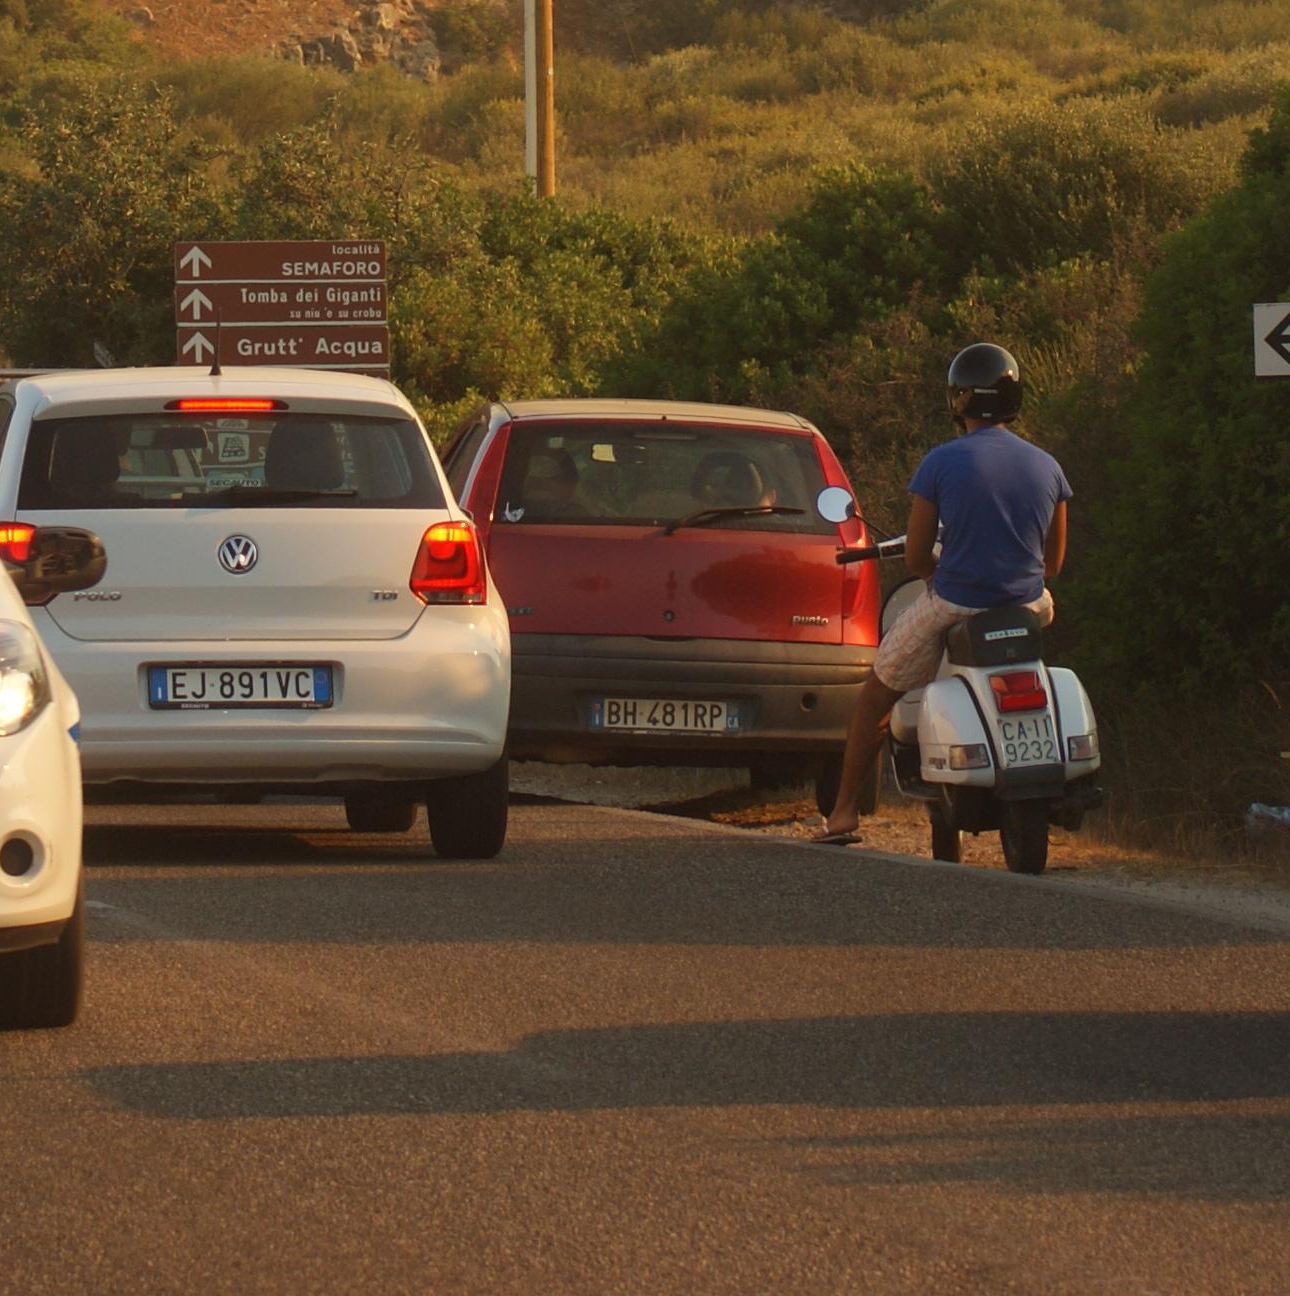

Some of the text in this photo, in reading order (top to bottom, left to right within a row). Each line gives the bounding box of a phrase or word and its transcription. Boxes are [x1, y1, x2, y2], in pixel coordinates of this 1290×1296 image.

[332, 245, 381, 255] località
[282, 262, 381, 276] SEMAFORO
[241, 287, 381, 305] Tomba dei Giganti
[237, 338, 383, 356] Grutt' Acqua
[74, 591, 122, 601] POLO
[373, 590, 398, 600] TDI
[172, 672, 206, 699] EJ
[219, 671, 311, 699] 891VC
[608, 701, 637, 725] BH
[1005, 740, 1054, 762] 9232
